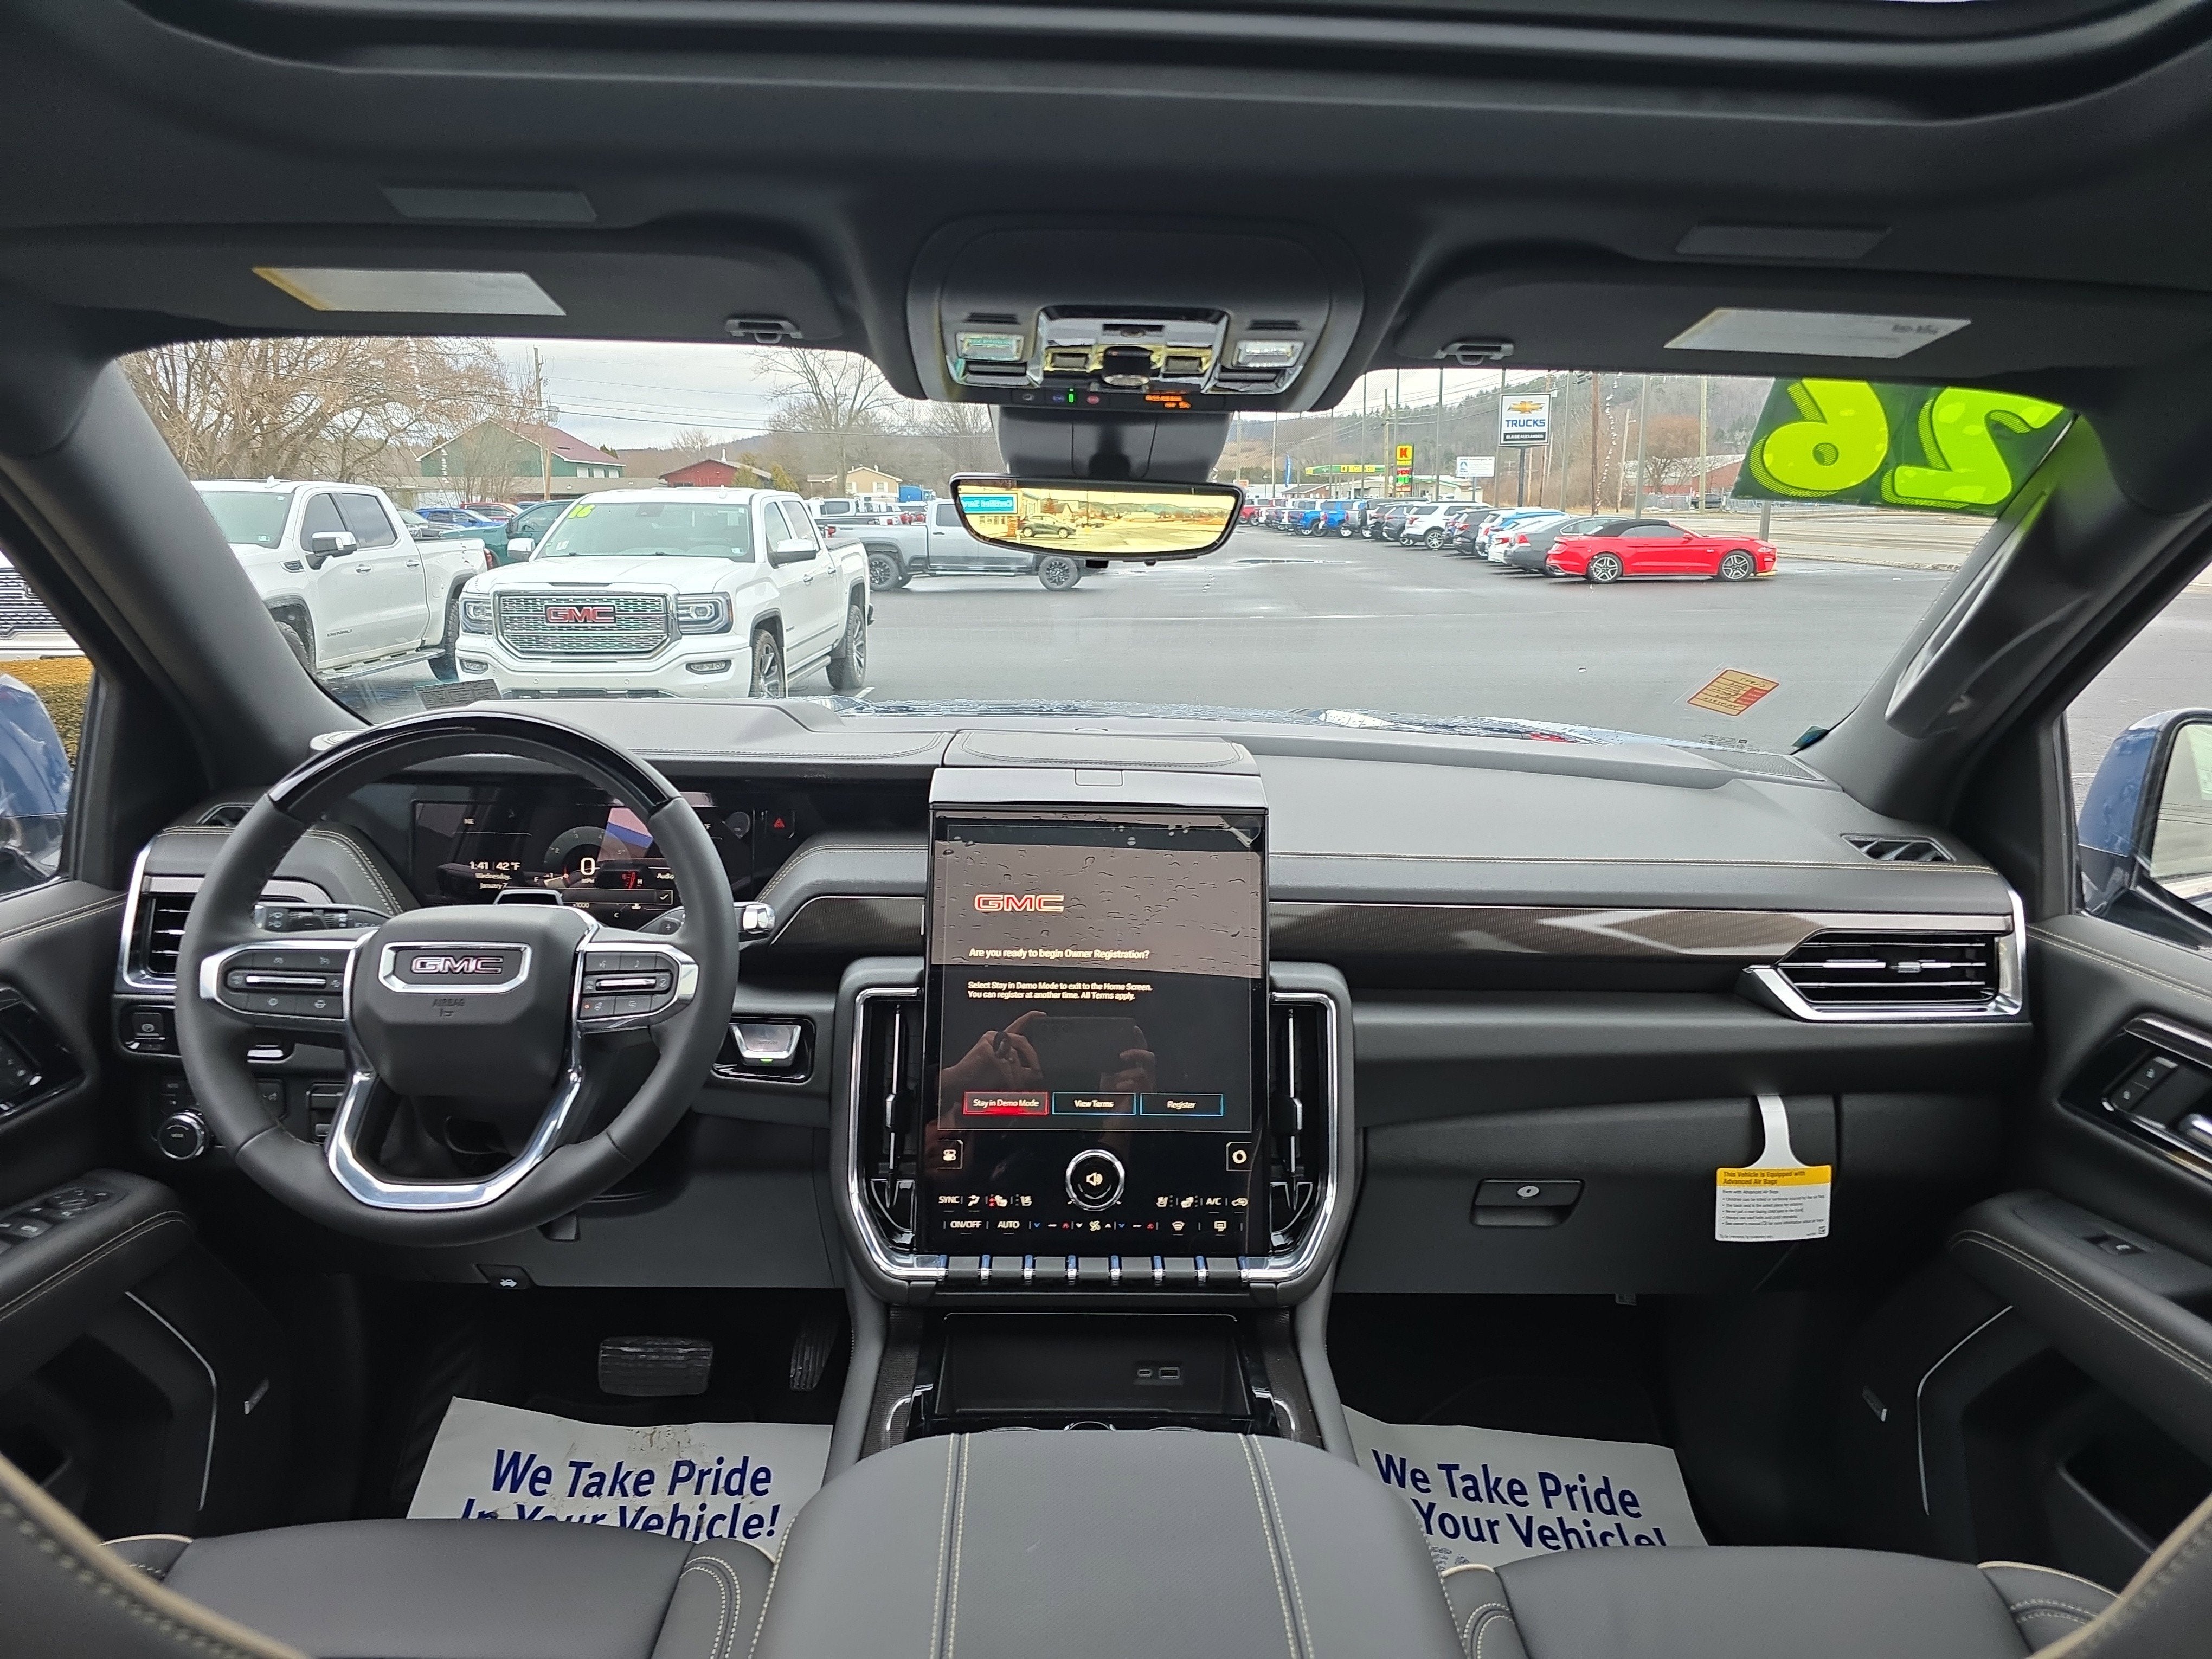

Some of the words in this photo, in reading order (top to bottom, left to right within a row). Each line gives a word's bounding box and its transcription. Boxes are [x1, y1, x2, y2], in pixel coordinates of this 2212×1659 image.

[1505, 419, 1546, 427] TRUCKS
[567, 504, 595, 519] 16
[545, 605, 616, 623] GMC
[326, 628, 353, 638] DENALI
[470, 861, 489, 870] 1:41
[580, 857, 596, 876] 0
[974, 893, 1065, 913] GMC
[969, 948, 985, 957] Are
[985, 949, 1002, 959] you
[1002, 948, 1028, 960] ready
[1028, 949, 1038, 957] to
[1039, 949, 1064, 960] begin
[1064, 949, 1093, 958] Owner
[1094, 949, 1150, 960] Registration?
[411, 955, 504, 974] GMC
[991, 982, 1007, 991] Stay
[996, 991, 1025, 1000] register
[1114, 992, 1135, 1001] apply.
[432, 998, 465, 1007] AIRBAG
[973, 1099, 989, 1108] Stay
[988, 1099, 996, 1107] in
[1167, 1101, 1196, 1110] Register
[1766, 1171, 1792, 1179] Equipped
[938, 1195, 960, 1204] SYNC
[1205, 1198, 1222, 1206] A/C
[950, 1220, 982, 1229] ON/OFF
[997, 1220, 1020, 1229] AUTO
[491, 1449, 552, 1497] We
[566, 1459, 657, 1499] Take
[666, 1455, 772, 1497] Pride
[1371, 1449, 1431, 1494] We
[1437, 1462, 1530, 1508] Take
[1537, 1471, 1644, 1519] Pride
[618, 1502, 780, 1542] Vehicle!
[1410, 1498, 1500, 1545] Your
